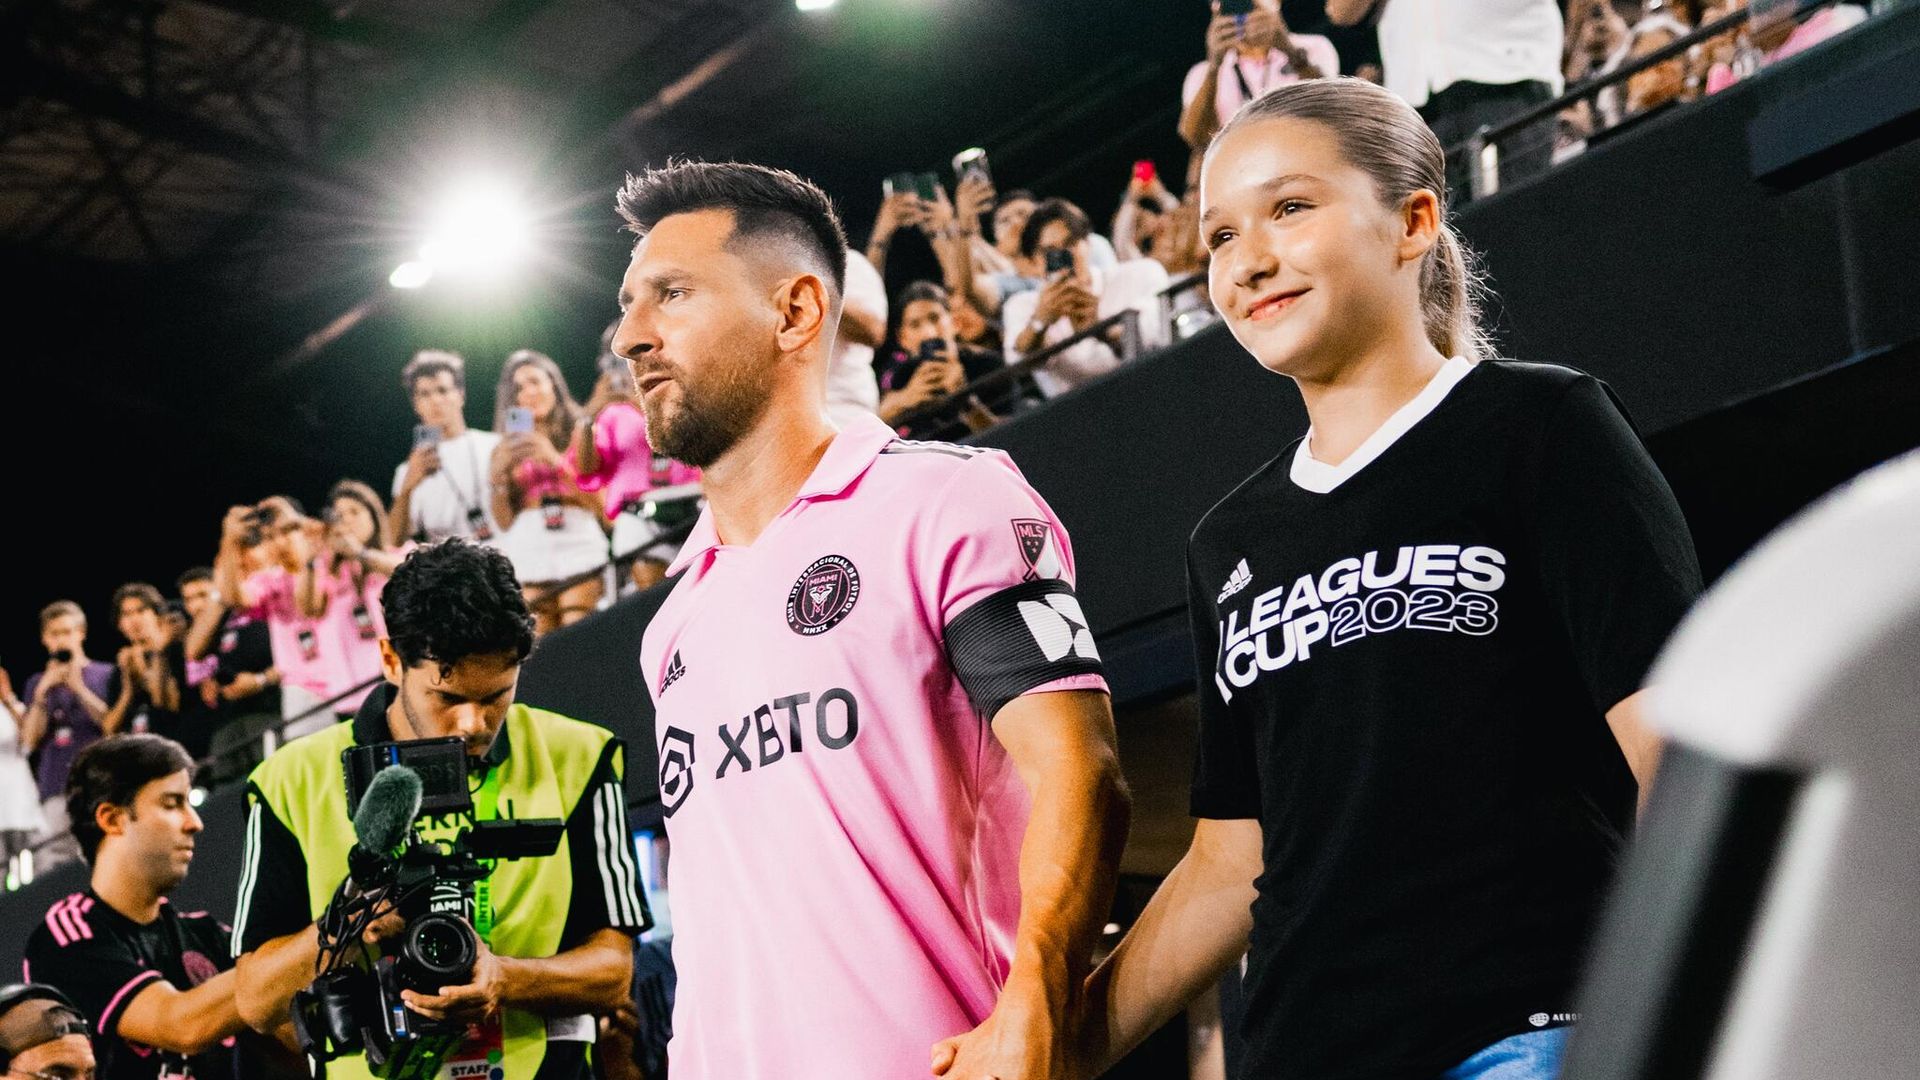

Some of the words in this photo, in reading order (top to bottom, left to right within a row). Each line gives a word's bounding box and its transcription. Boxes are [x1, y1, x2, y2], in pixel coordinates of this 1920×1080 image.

[1019, 525, 1043, 538] MLS
[809, 574, 838, 586] MIAMI
[1226, 545, 1506, 650] LEAGUES
[1225, 610, 1329, 688] CUP
[1329, 588, 1498, 647] 2023
[716, 688, 858, 779] XBTO
[480, 887, 489, 923] INTER
[451, 1064, 490, 1076] STAFF
